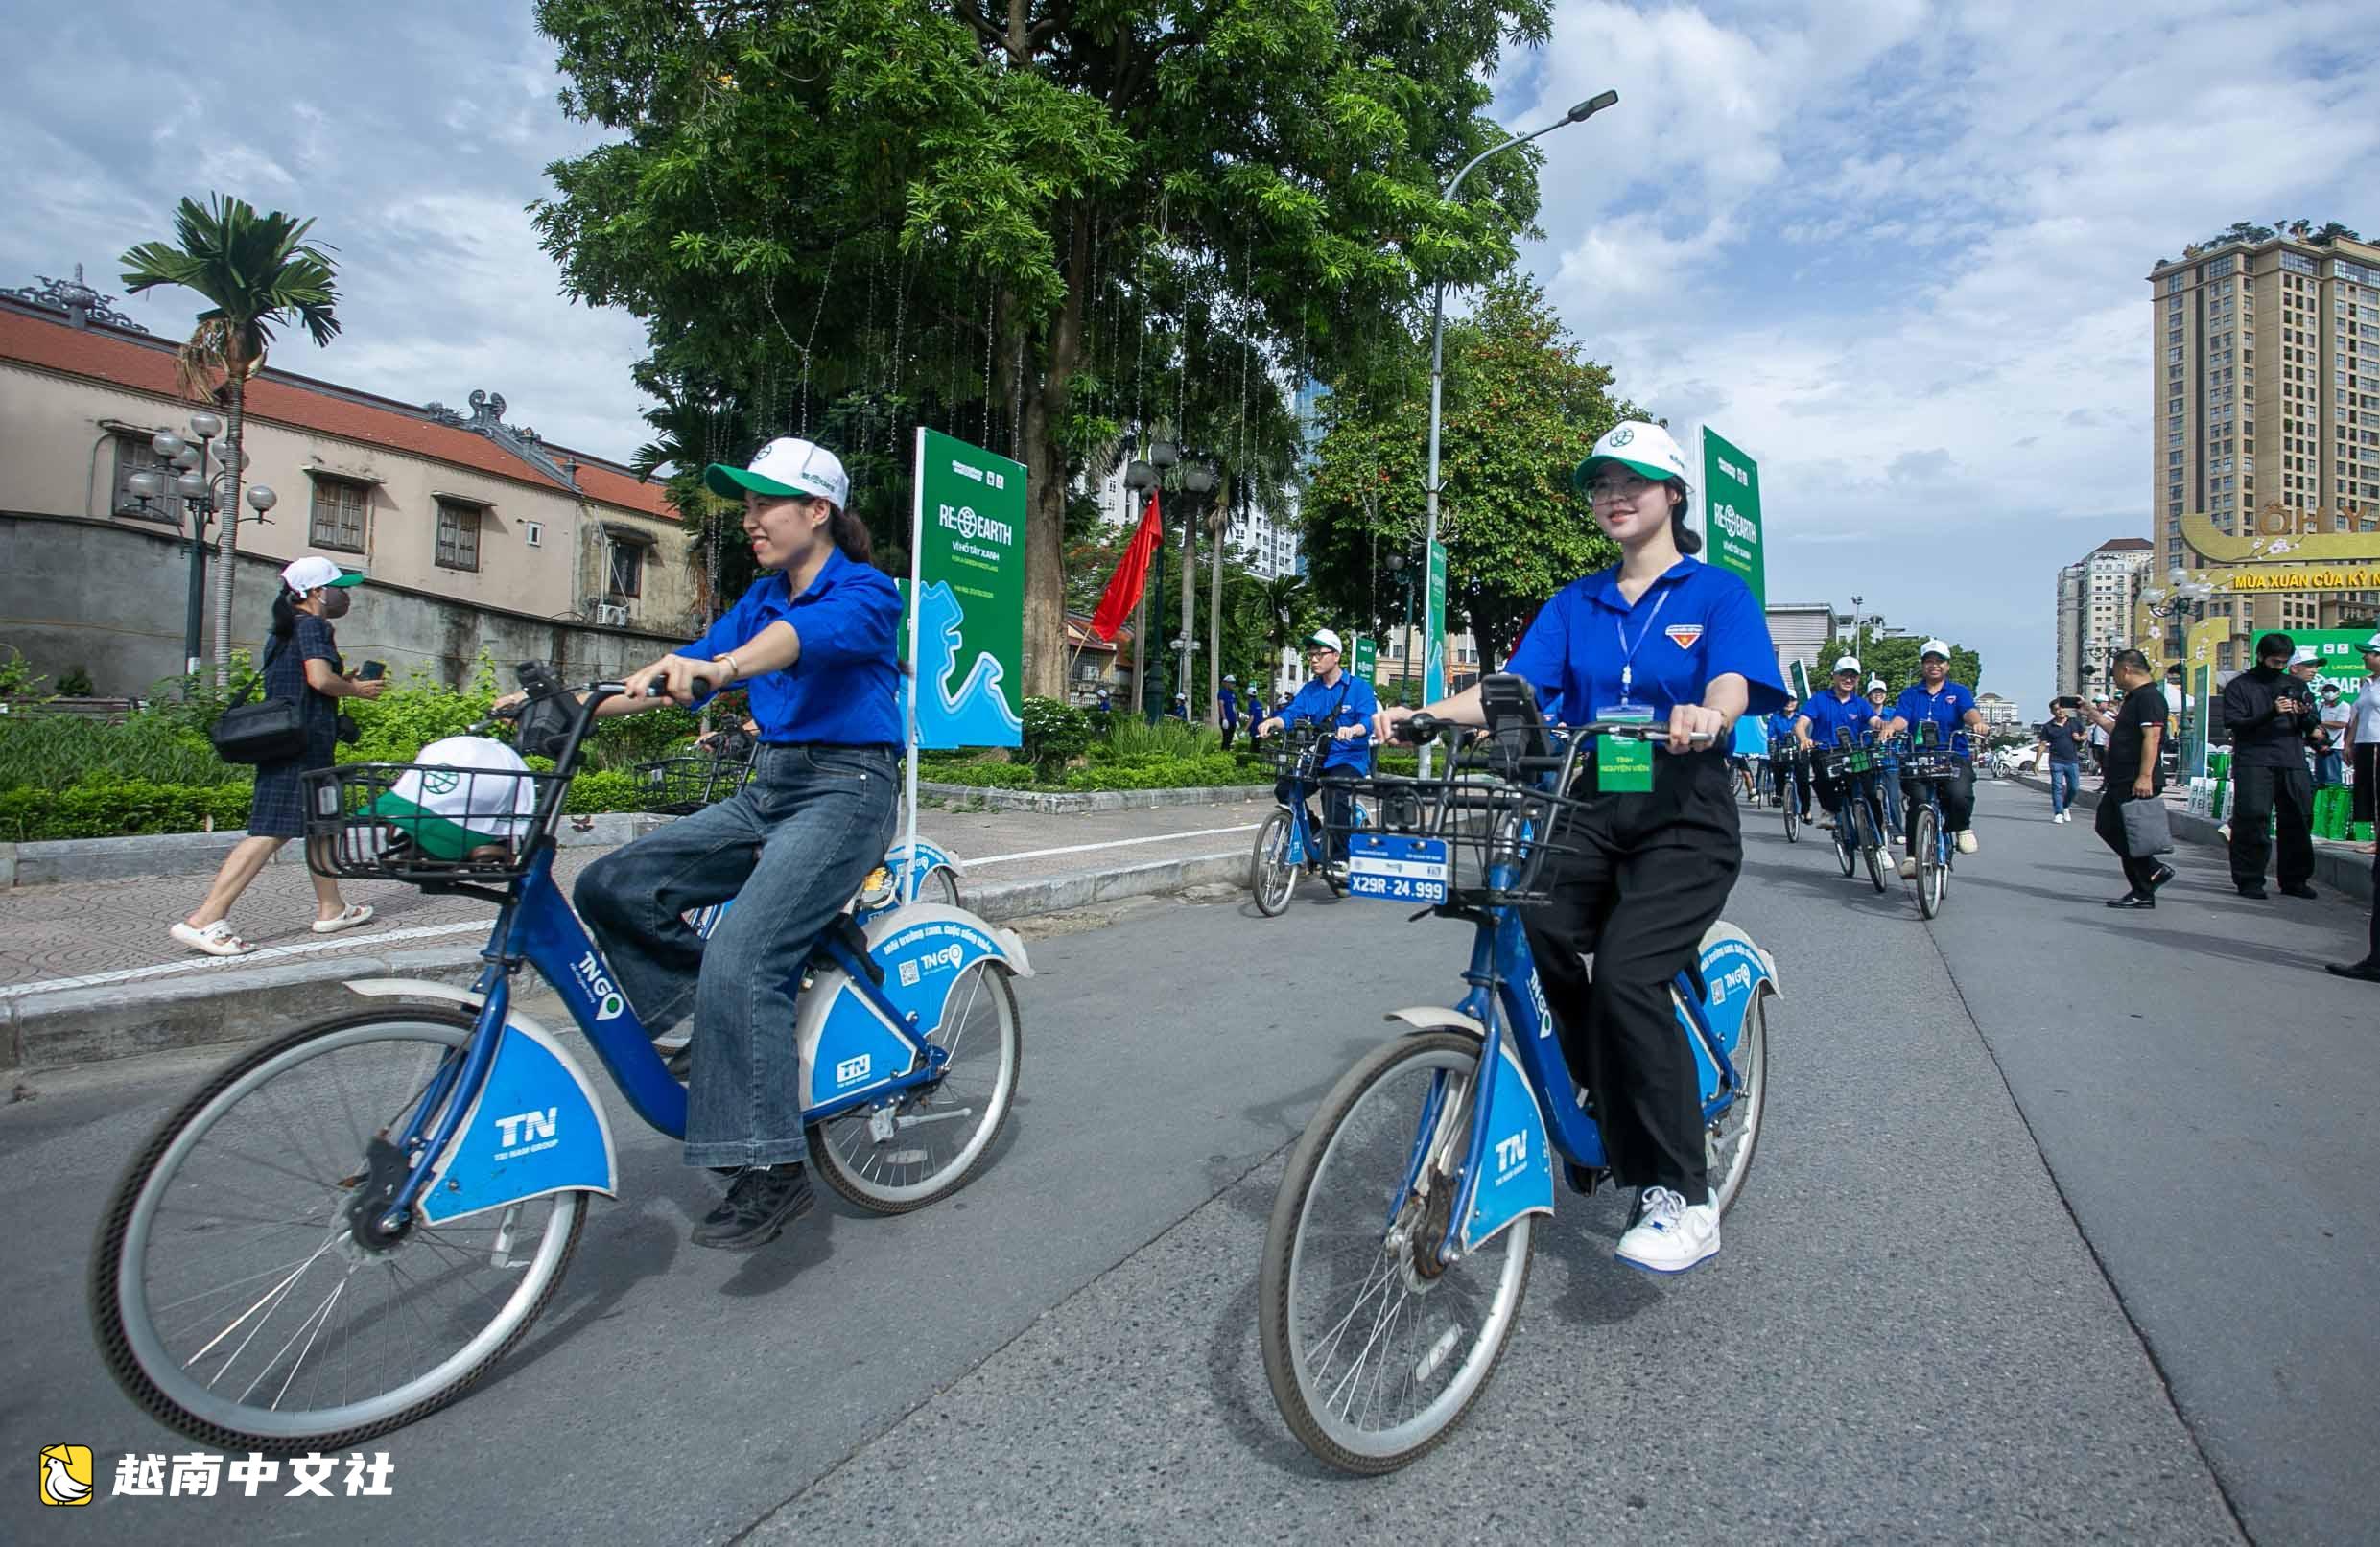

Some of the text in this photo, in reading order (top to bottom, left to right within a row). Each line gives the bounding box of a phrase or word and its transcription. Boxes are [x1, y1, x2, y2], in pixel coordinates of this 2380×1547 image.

[978, 515, 1012, 546] EARTH
[1735, 513, 1756, 545] EARTH
[2234, 572, 2266, 589] MÙA
[2312, 570, 2344, 589] CỦA
[495, 1107, 557, 1148] TN
[1496, 1128, 1527, 1173] TN
